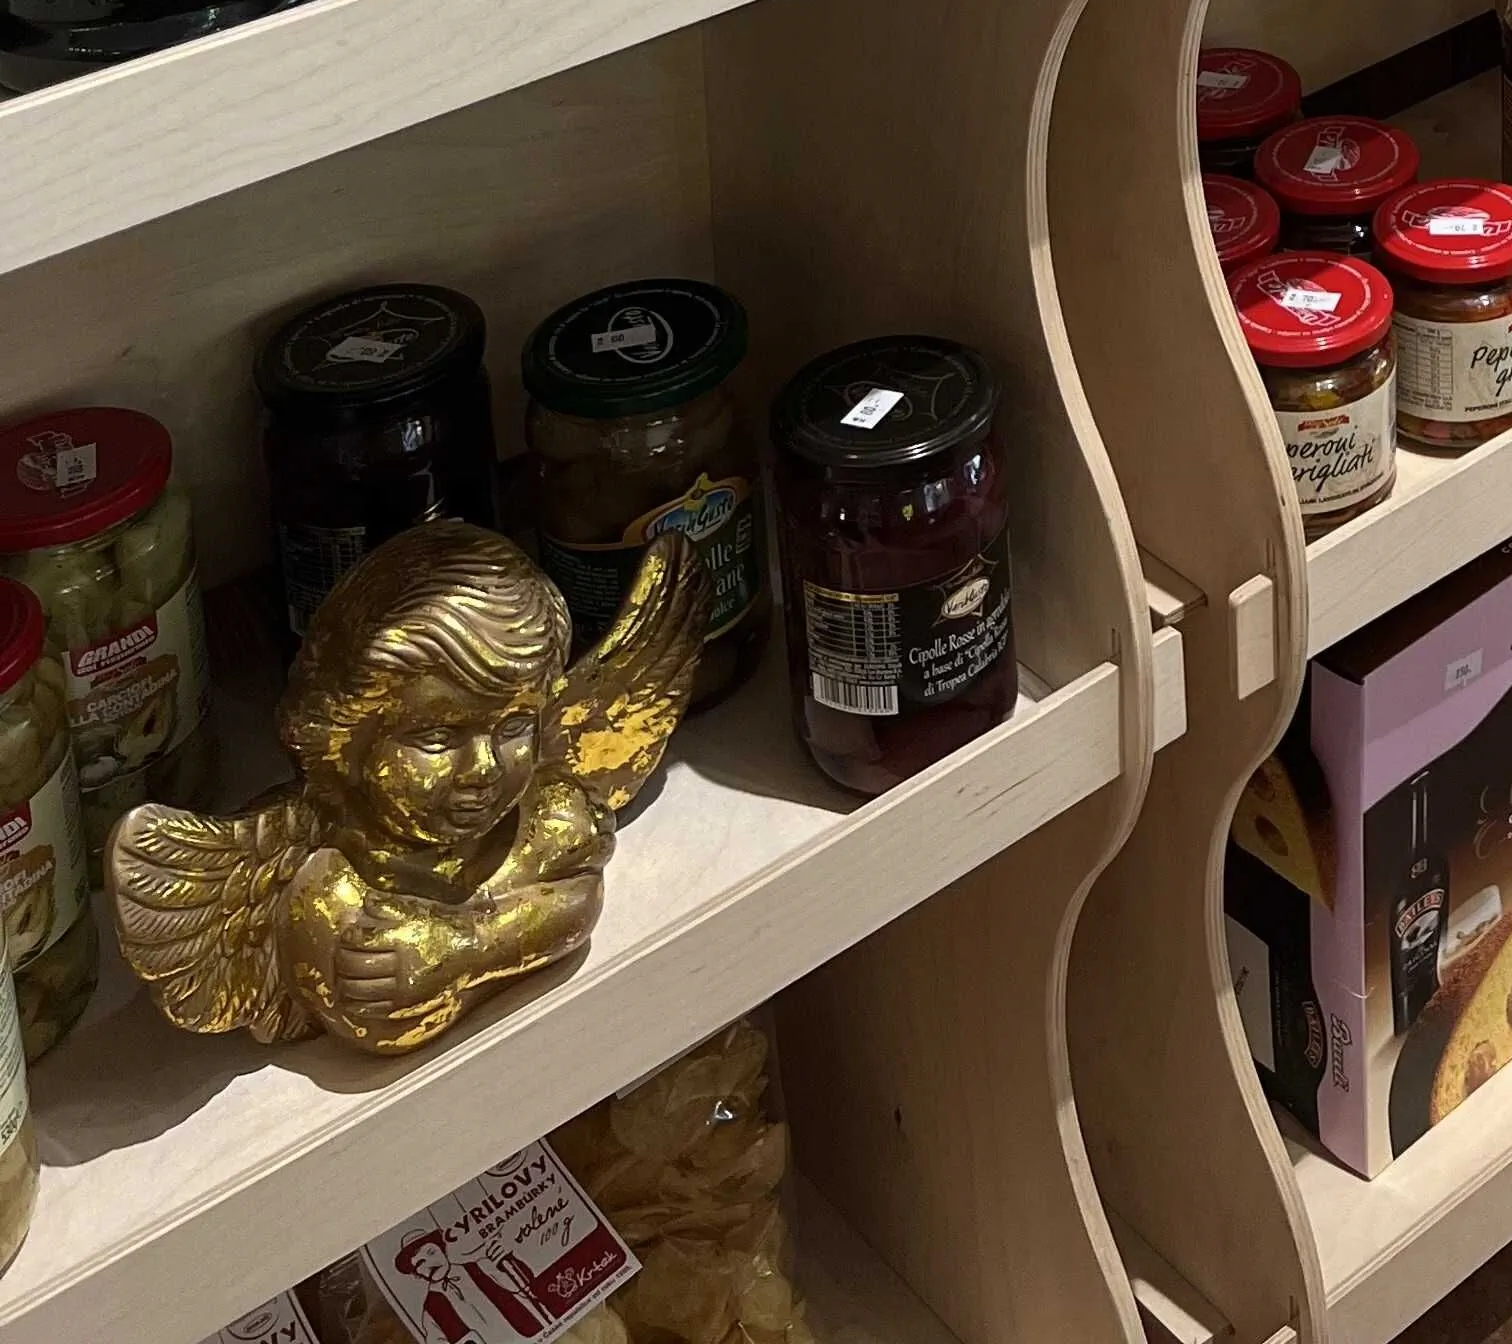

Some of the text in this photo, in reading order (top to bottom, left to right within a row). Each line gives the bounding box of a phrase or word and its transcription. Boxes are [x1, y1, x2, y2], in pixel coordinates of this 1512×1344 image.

[78, 625, 154, 667] GRANDI
[909, 638, 947, 667] Cipolle
[949, 628, 976, 651] Rosse
[932, 661, 952, 676] base
[954, 652, 964, 667] di
[924, 672, 967, 696] di Tropea
[443, 1155, 548, 1243] CYRILOVY
